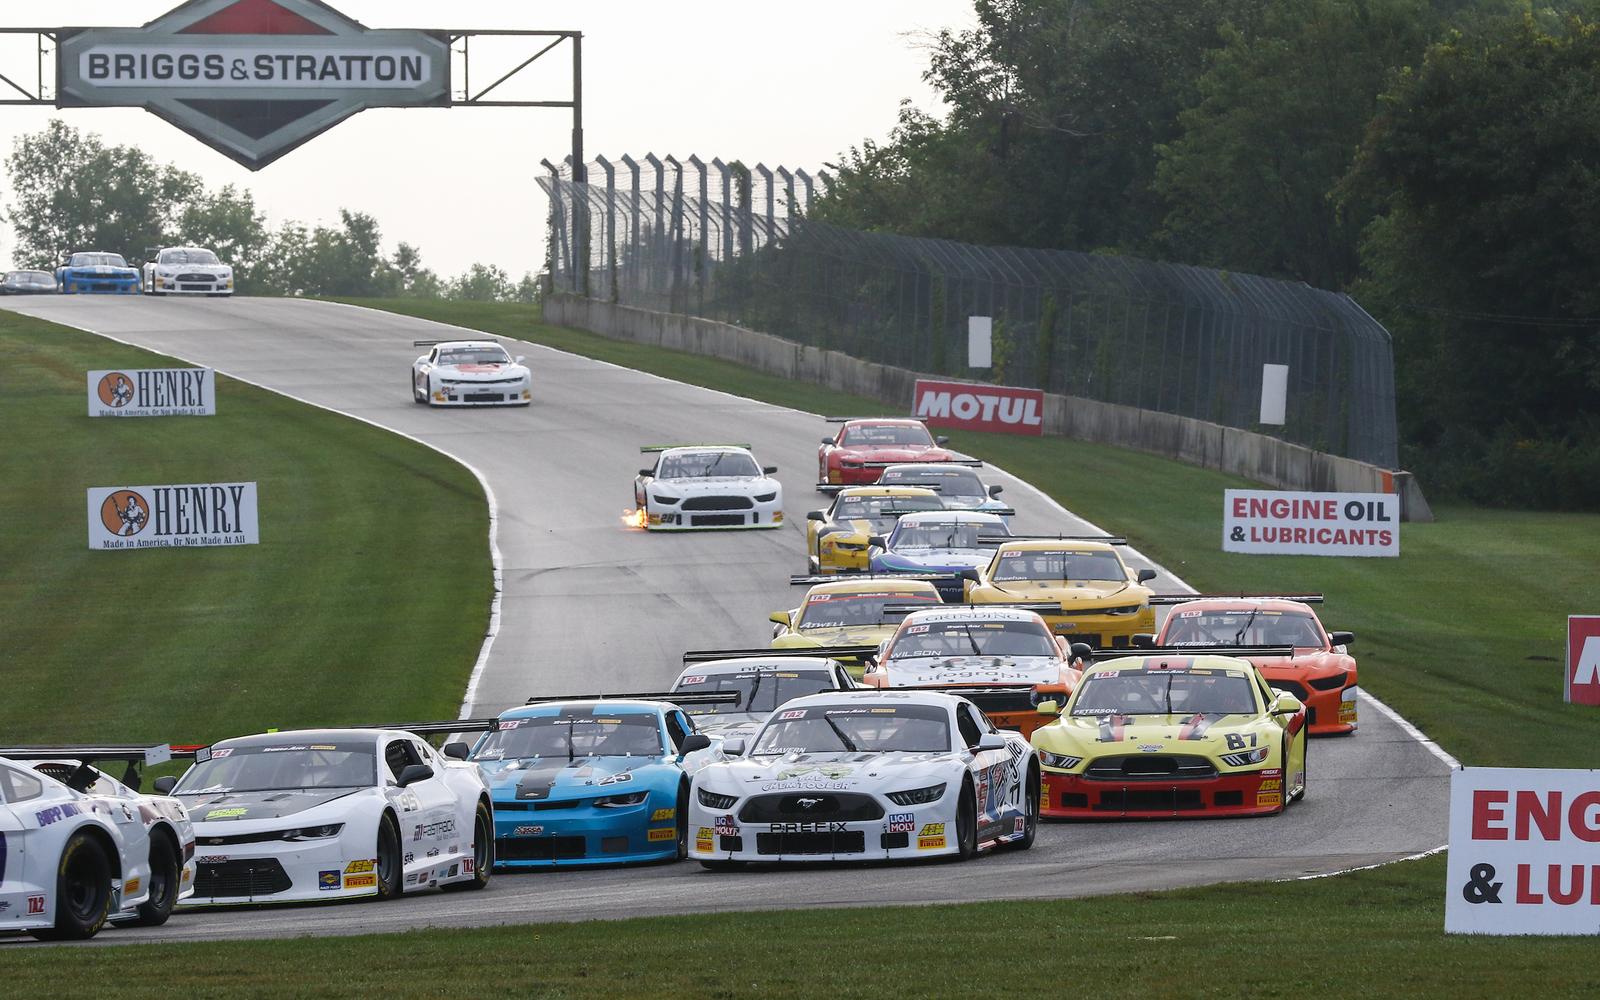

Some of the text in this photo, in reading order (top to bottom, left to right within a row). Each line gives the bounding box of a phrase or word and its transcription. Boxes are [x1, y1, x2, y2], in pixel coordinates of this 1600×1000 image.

[88, 54, 423, 82] BRIGGS & STRATTON
[137, 370, 205, 407] HENRY
[917, 391, 1042, 425] MOTUL
[153, 485, 245, 536] HENRY
[1232, 497, 1391, 522] ENGINE OIL
[103, 535, 245, 549] Made in America, Or Not Made At All
[1230, 526, 1392, 546] & LUBRICANTS
[891, 650, 942, 659] WILSON
[686, 676, 704, 684] TA2
[1225, 732, 1257, 751] 87
[890, 813, 914, 823] LIQUI
[1471, 789, 1600, 843] ENG
[770, 822, 848, 833] PREFIX
[890, 823, 915, 832] MOLY
[462, 859, 474, 872] TA2
[1462, 862, 1600, 906] & LU
[27, 896, 44, 914] TA2
